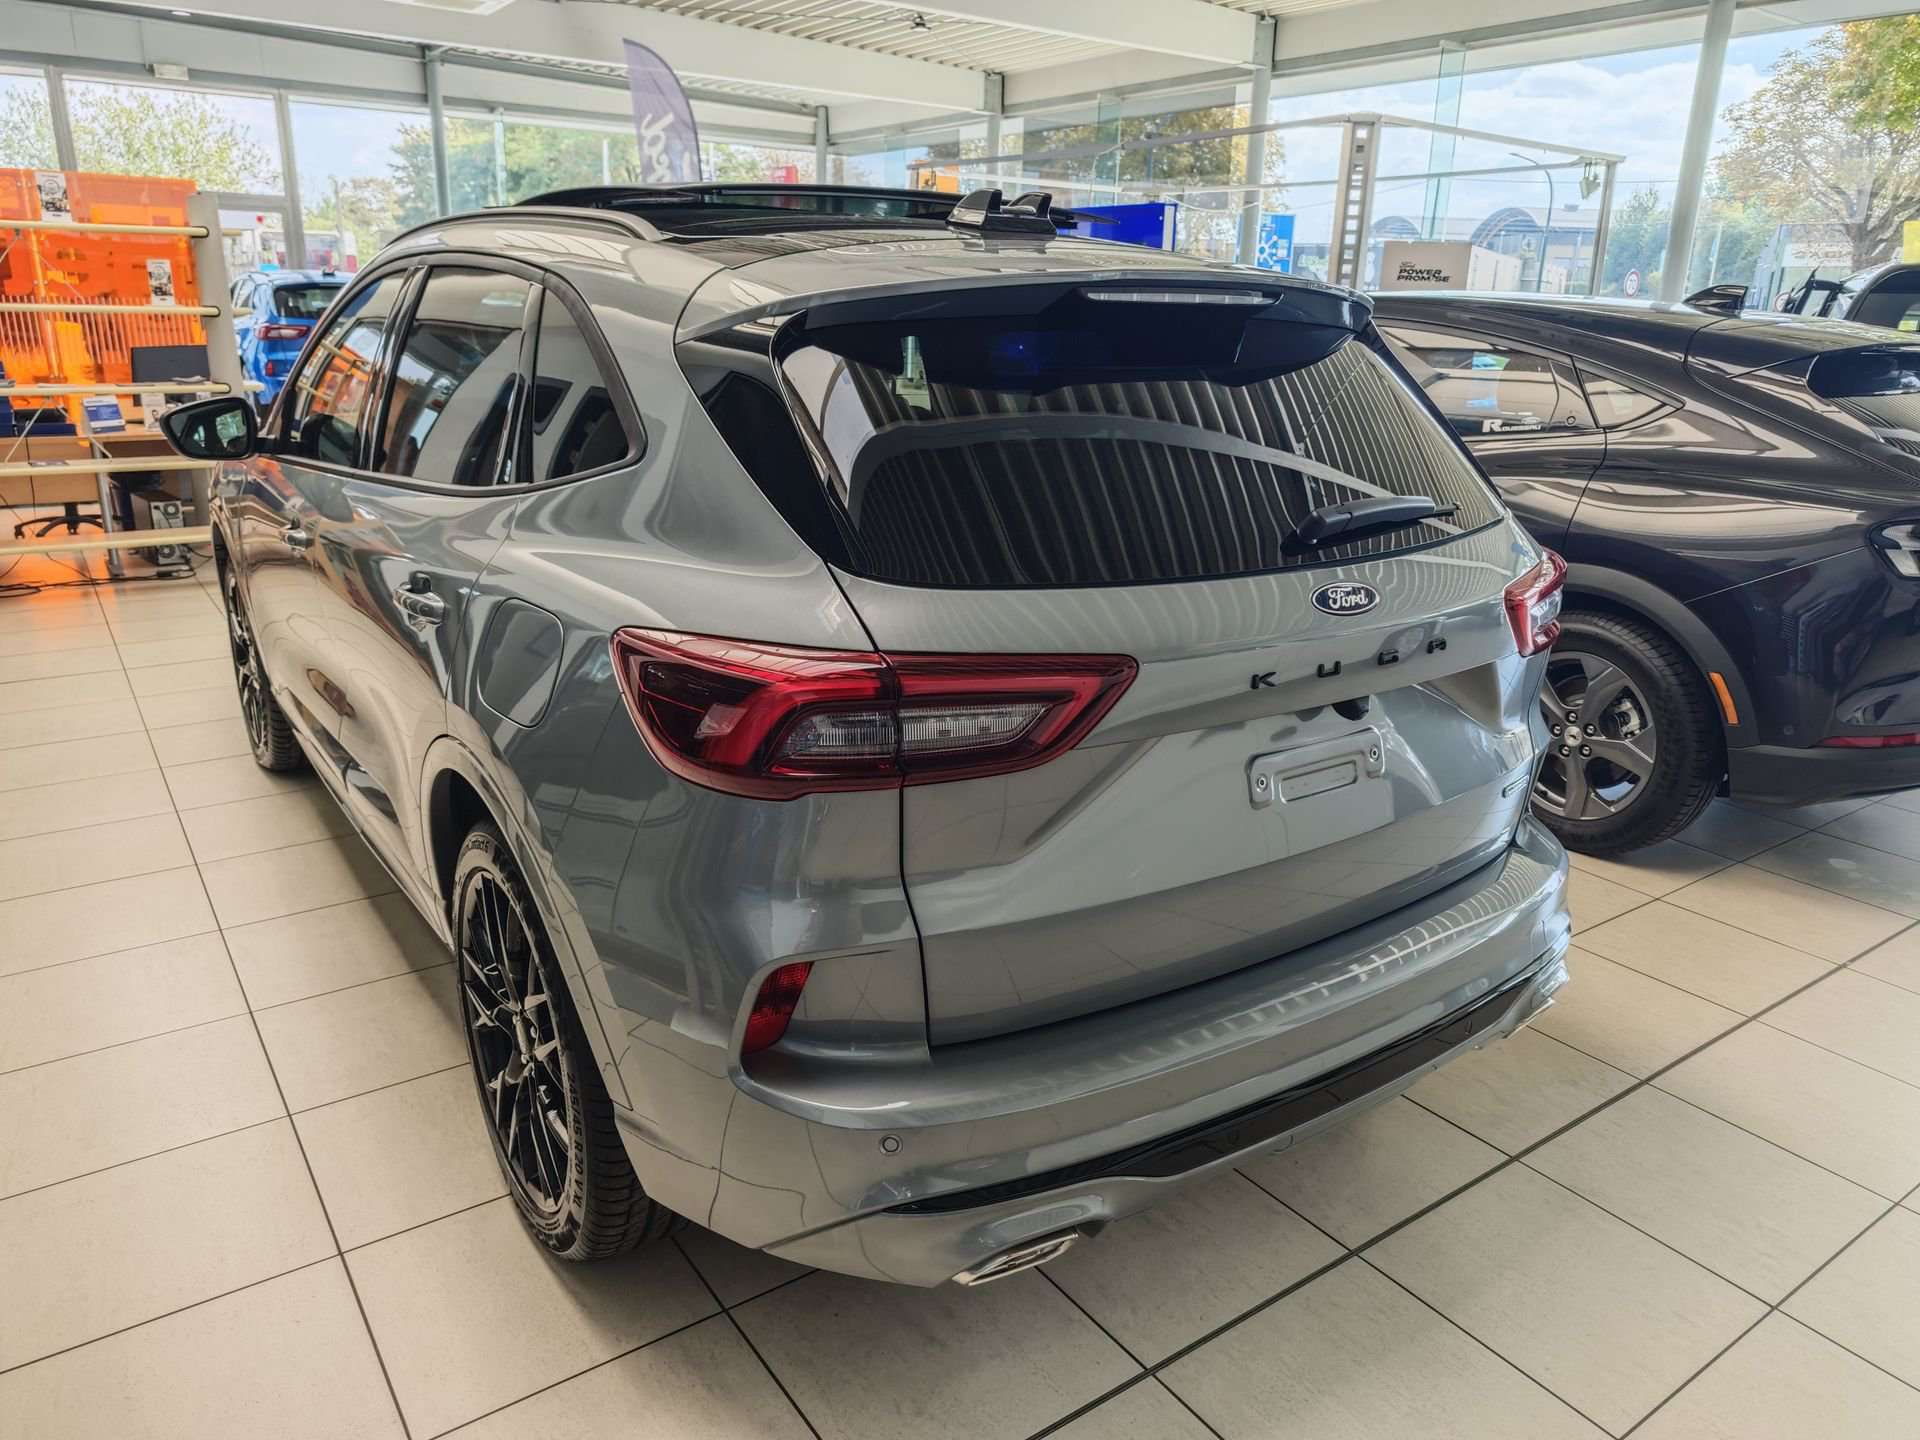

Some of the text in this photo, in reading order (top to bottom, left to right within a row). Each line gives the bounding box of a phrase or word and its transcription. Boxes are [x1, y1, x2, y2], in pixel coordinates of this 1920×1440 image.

[1397, 274, 1451, 283] PROMISE
[1328, 587, 1368, 609] Ford
[1250, 638, 1447, 689] KUGA
